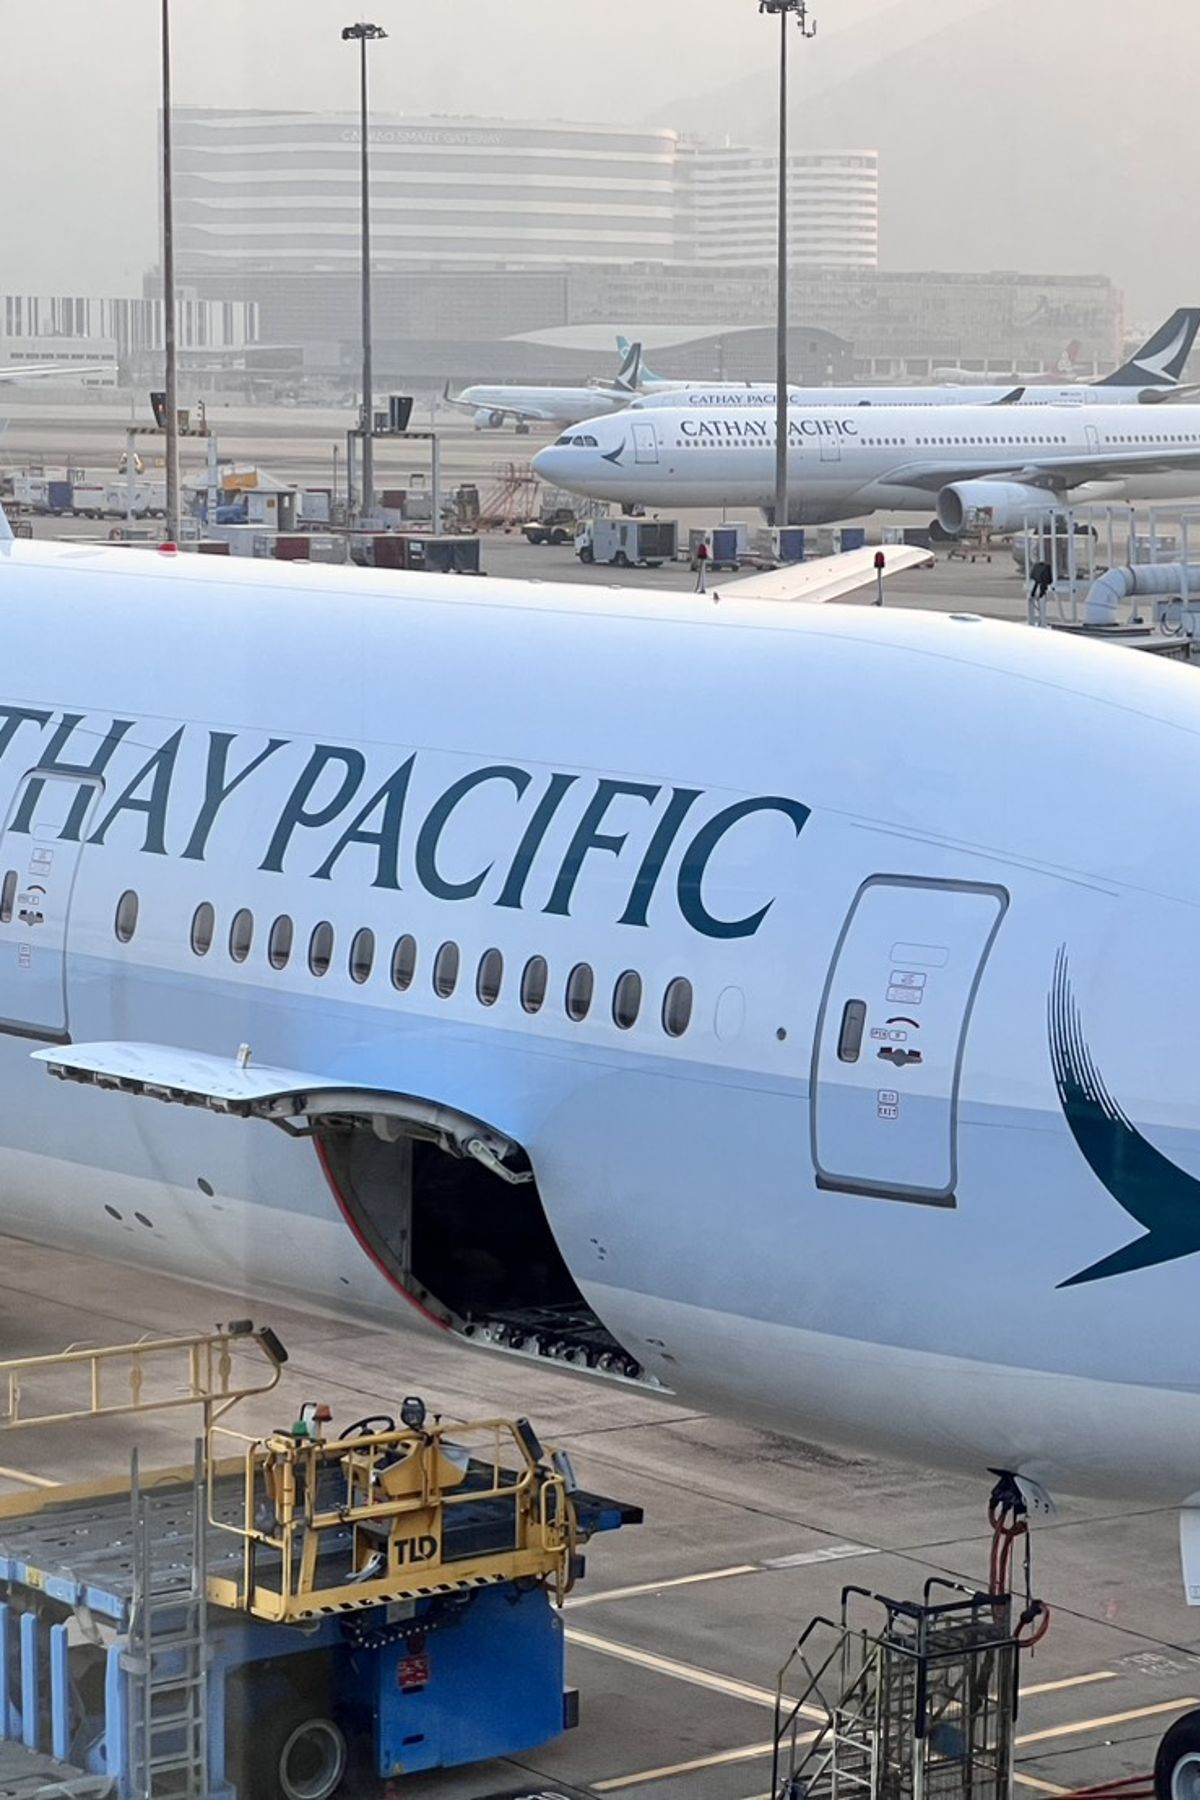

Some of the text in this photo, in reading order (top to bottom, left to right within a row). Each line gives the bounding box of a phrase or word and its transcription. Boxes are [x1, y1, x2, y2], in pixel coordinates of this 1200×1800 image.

[689, 394, 743, 404] CATHAY
[680, 420, 858, 436] CATHAY ACIFIC
[257, 743, 812, 939] PACIFIC
[394, 1534, 438, 1565] TLD
